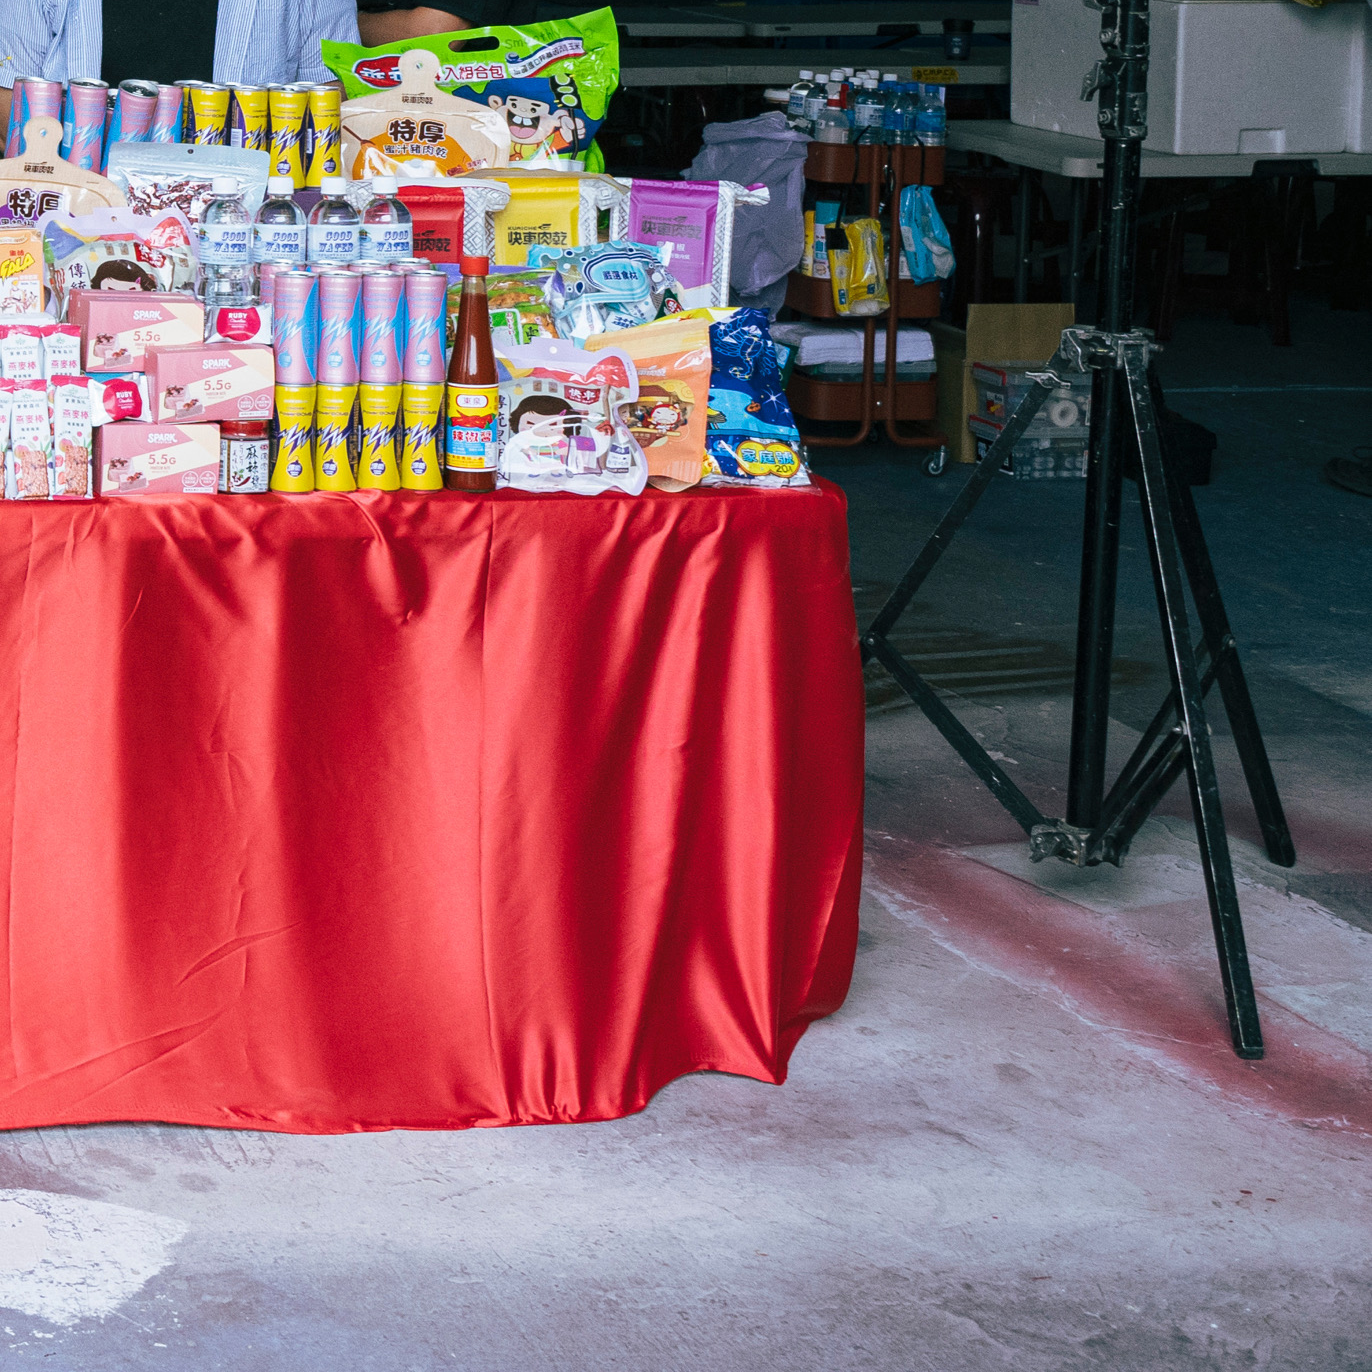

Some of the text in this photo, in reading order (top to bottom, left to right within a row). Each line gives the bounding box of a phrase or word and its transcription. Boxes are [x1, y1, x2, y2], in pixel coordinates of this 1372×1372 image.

[388, 119, 447, 144] 特厚
[383, 145, 448, 159] 蜜汁豬肉乾
[221, 231, 246, 242] GOOD
[325, 231, 352, 241] GOOD
[384, 230, 409, 241] GOOD
[508, 231, 567, 246] 快車肉乾
[213, 242, 248, 253] WATER
[318, 241, 354, 253] WATER
[376, 241, 410, 252] WATER
[0, 253, 35, 279] FALA
[133, 310, 162, 320] SPARK
[133, 330, 161, 342] 5.5G
[51, 359, 78, 369] 燕麥棒
[202, 359, 232, 369] SPARK
[204, 380, 232, 391] 5.5G
[463, 397, 482, 406] 東泉
[16, 414, 45, 424] 燕麥棒
[62, 408, 89, 419] 燕麥棒
[148, 432, 178, 444] SPARK
[452, 430, 493, 443] 辣椒醬
[148, 454, 176, 465] 5.5G
[741, 448, 794, 466] 家庭號
